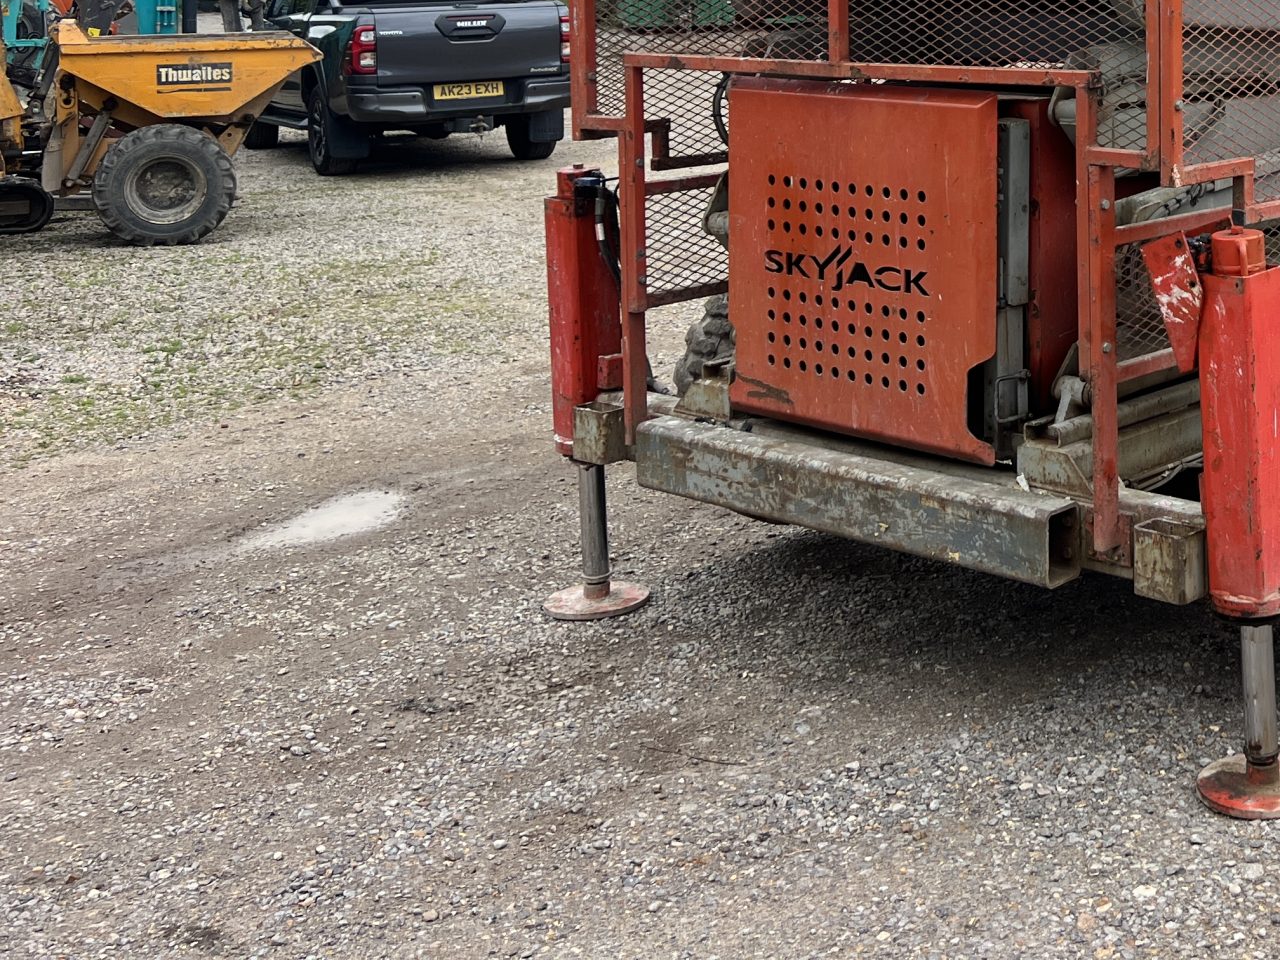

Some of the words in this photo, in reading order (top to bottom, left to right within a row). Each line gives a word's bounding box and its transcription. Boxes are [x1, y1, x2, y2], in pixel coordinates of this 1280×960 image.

[158, 67, 231, 83] Thwaites
[440, 84, 472, 97] AK23
[475, 83, 499, 95] EXH
[764, 243, 931, 297] SKYJACK
